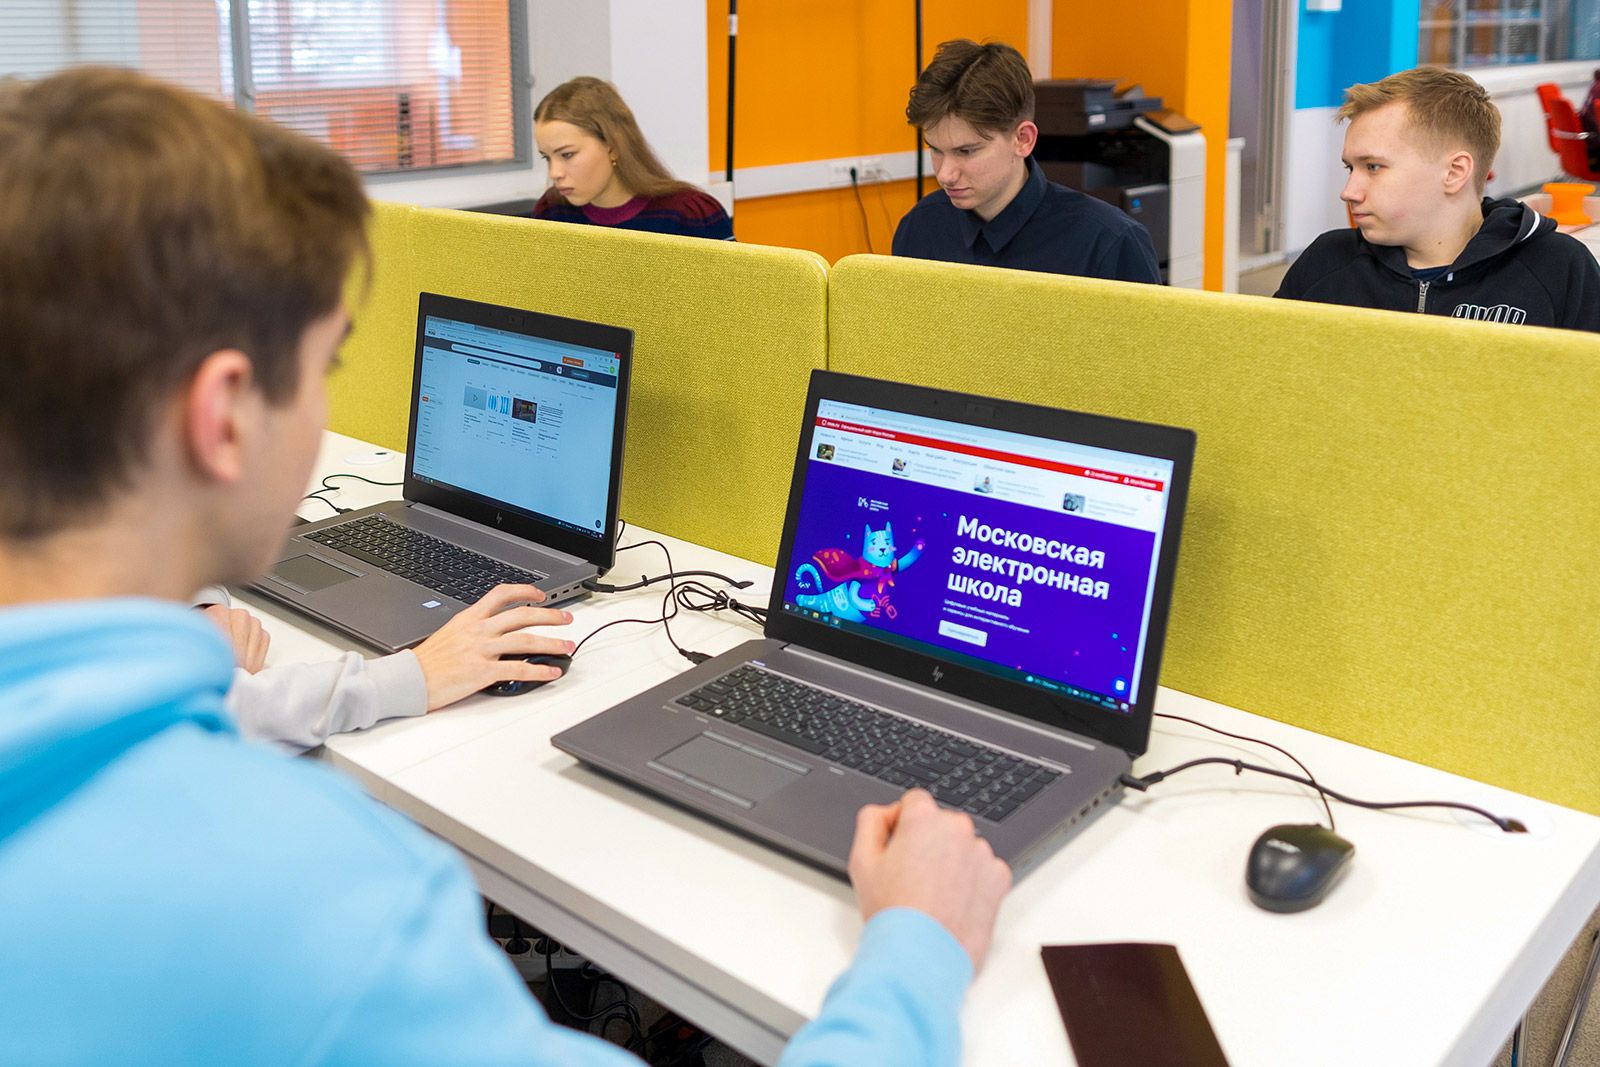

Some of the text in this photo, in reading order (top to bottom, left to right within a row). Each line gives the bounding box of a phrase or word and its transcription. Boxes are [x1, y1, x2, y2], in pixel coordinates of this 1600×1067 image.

[957, 515, 1105, 569] Московская
[947, 573, 1022, 607] школа
[951, 547, 1110, 600] электронная
